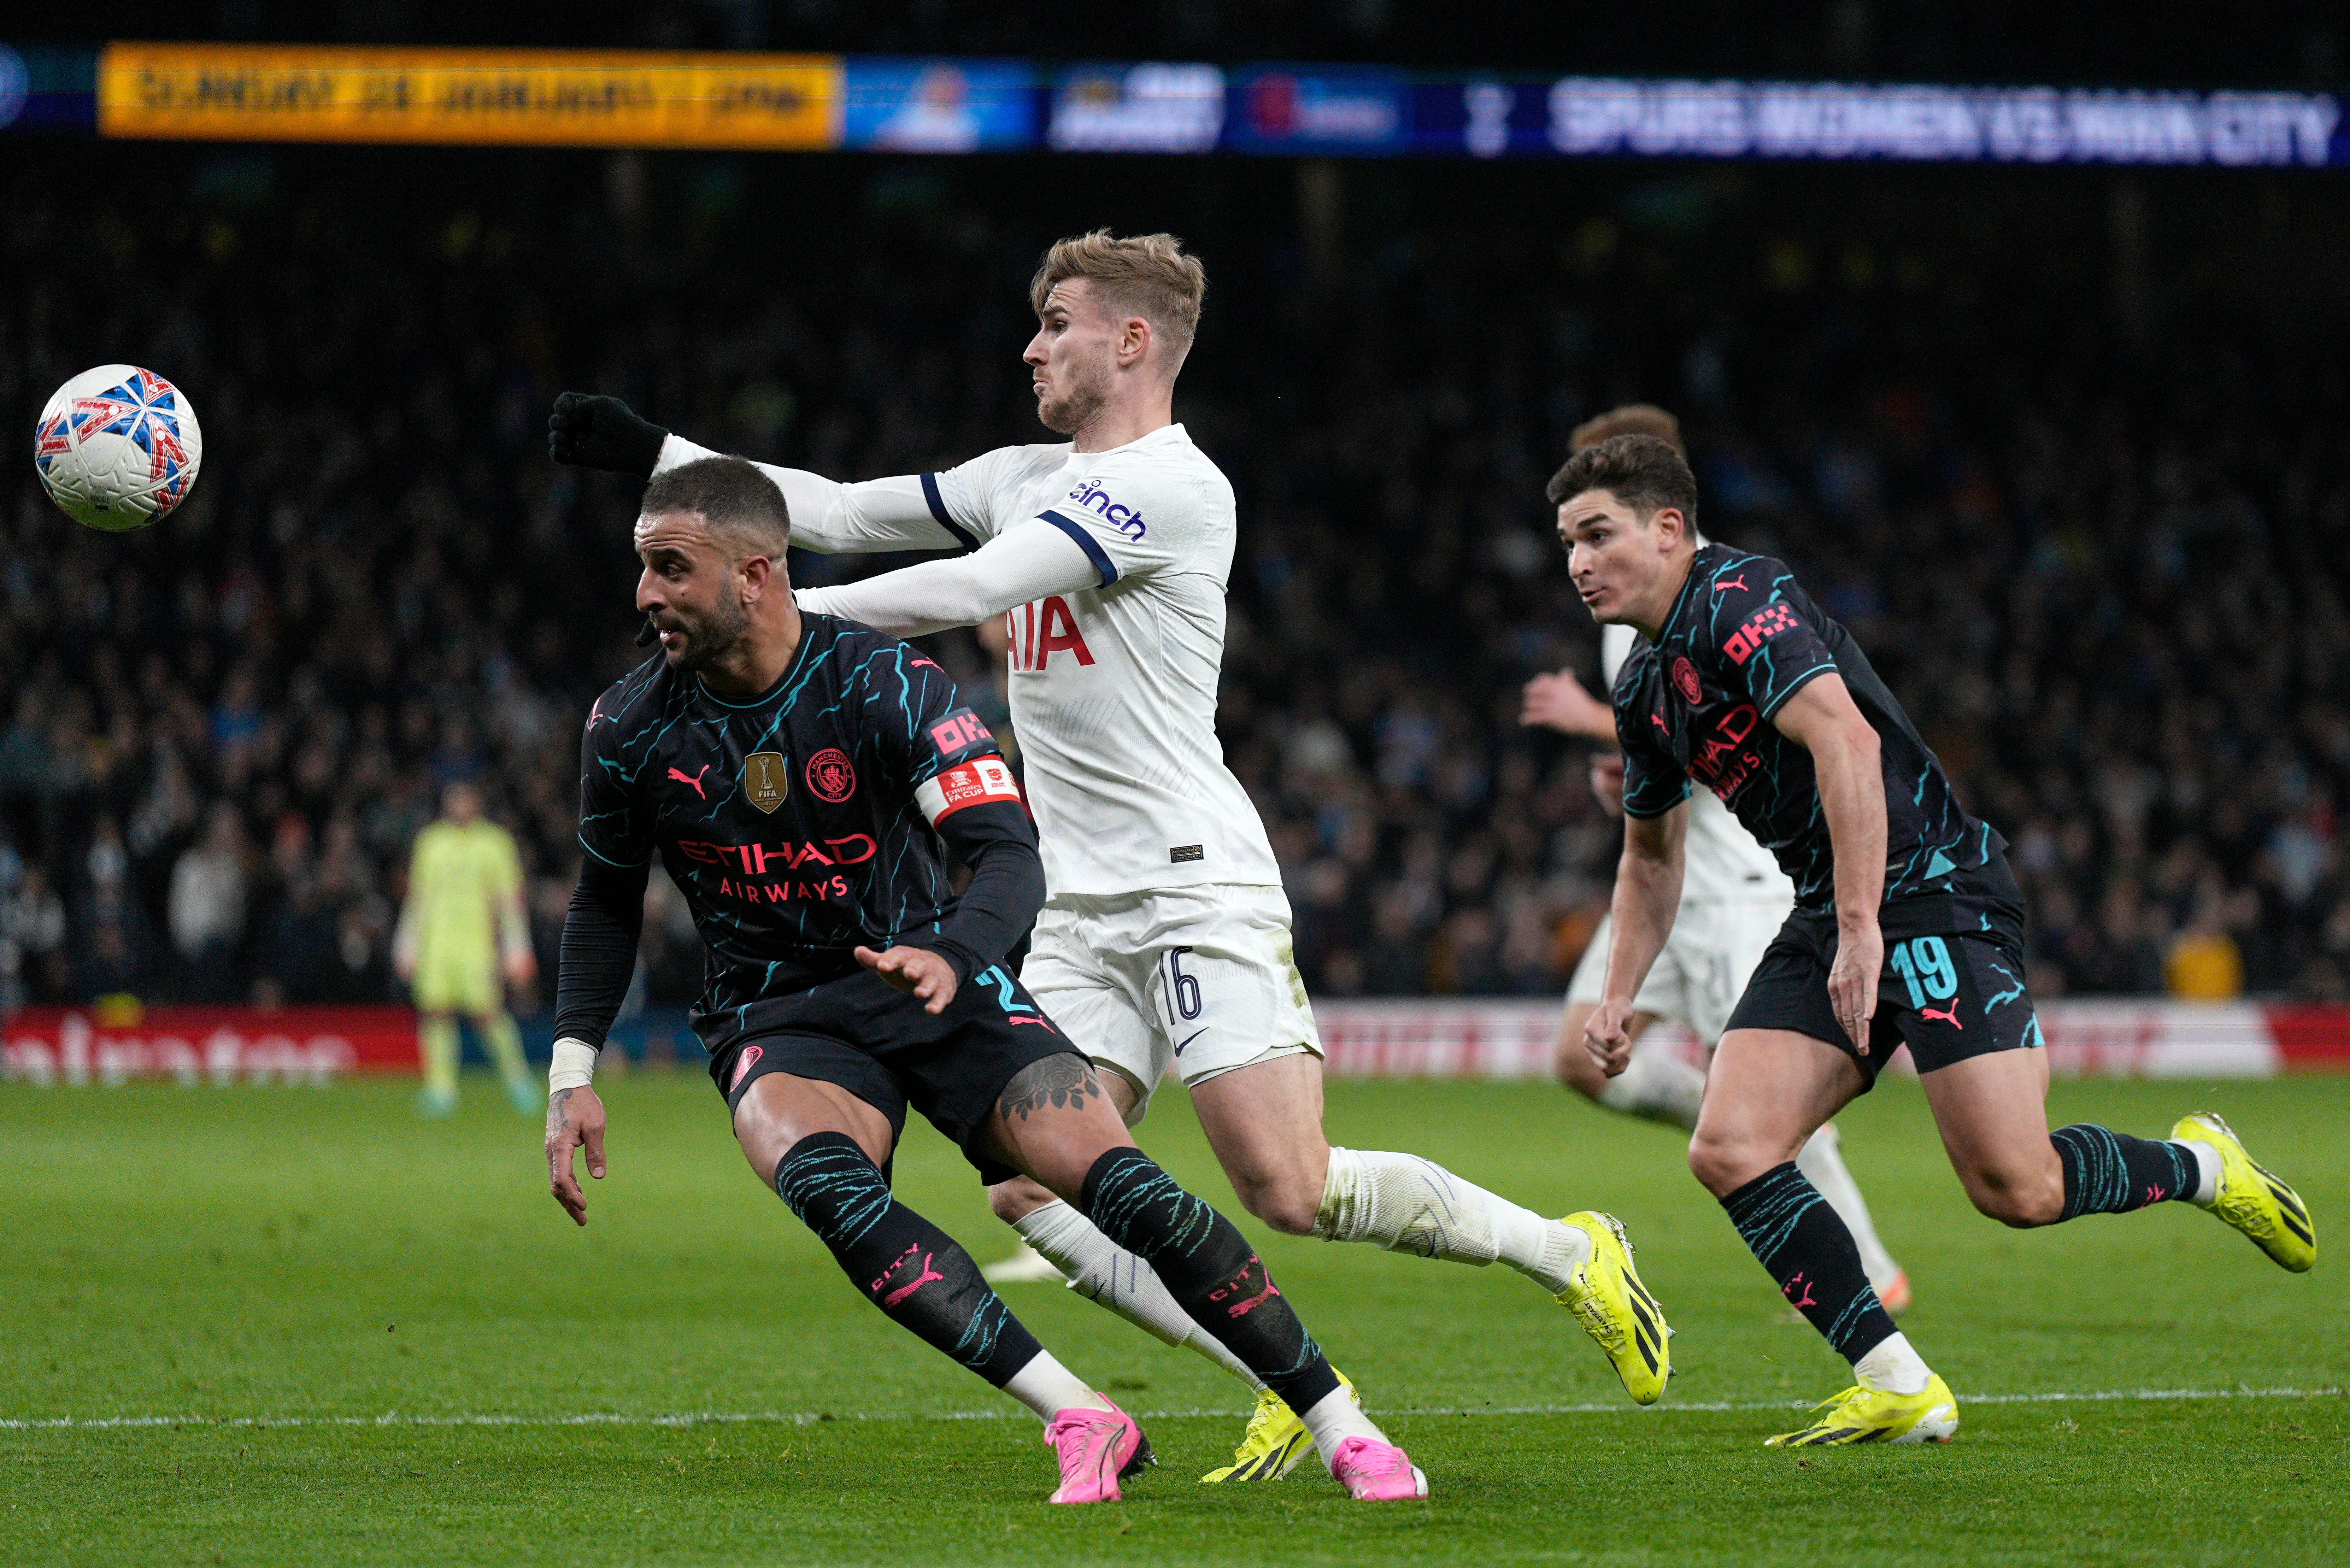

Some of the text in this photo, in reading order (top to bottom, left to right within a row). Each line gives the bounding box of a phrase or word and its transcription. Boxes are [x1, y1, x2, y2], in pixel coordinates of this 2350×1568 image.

[1550, 77, 2339, 165] SPURS WOMEN VS MAN CITY
[1069, 480, 1146, 542] cinch
[812, 753, 849, 770] MANCHESTER
[758, 790, 777, 798] FIFA
[946, 784, 982, 797] Emirates
[948, 788, 983, 803] FA CUP
[677, 833, 877, 875] ETIHAD
[720, 875, 847, 904] AIRWAYS
[1159, 946, 1202, 1026] 16
[1891, 936, 1958, 1010] 19
[871, 1243, 919, 1291] CITY
[1209, 1254, 1259, 1302] CITY
